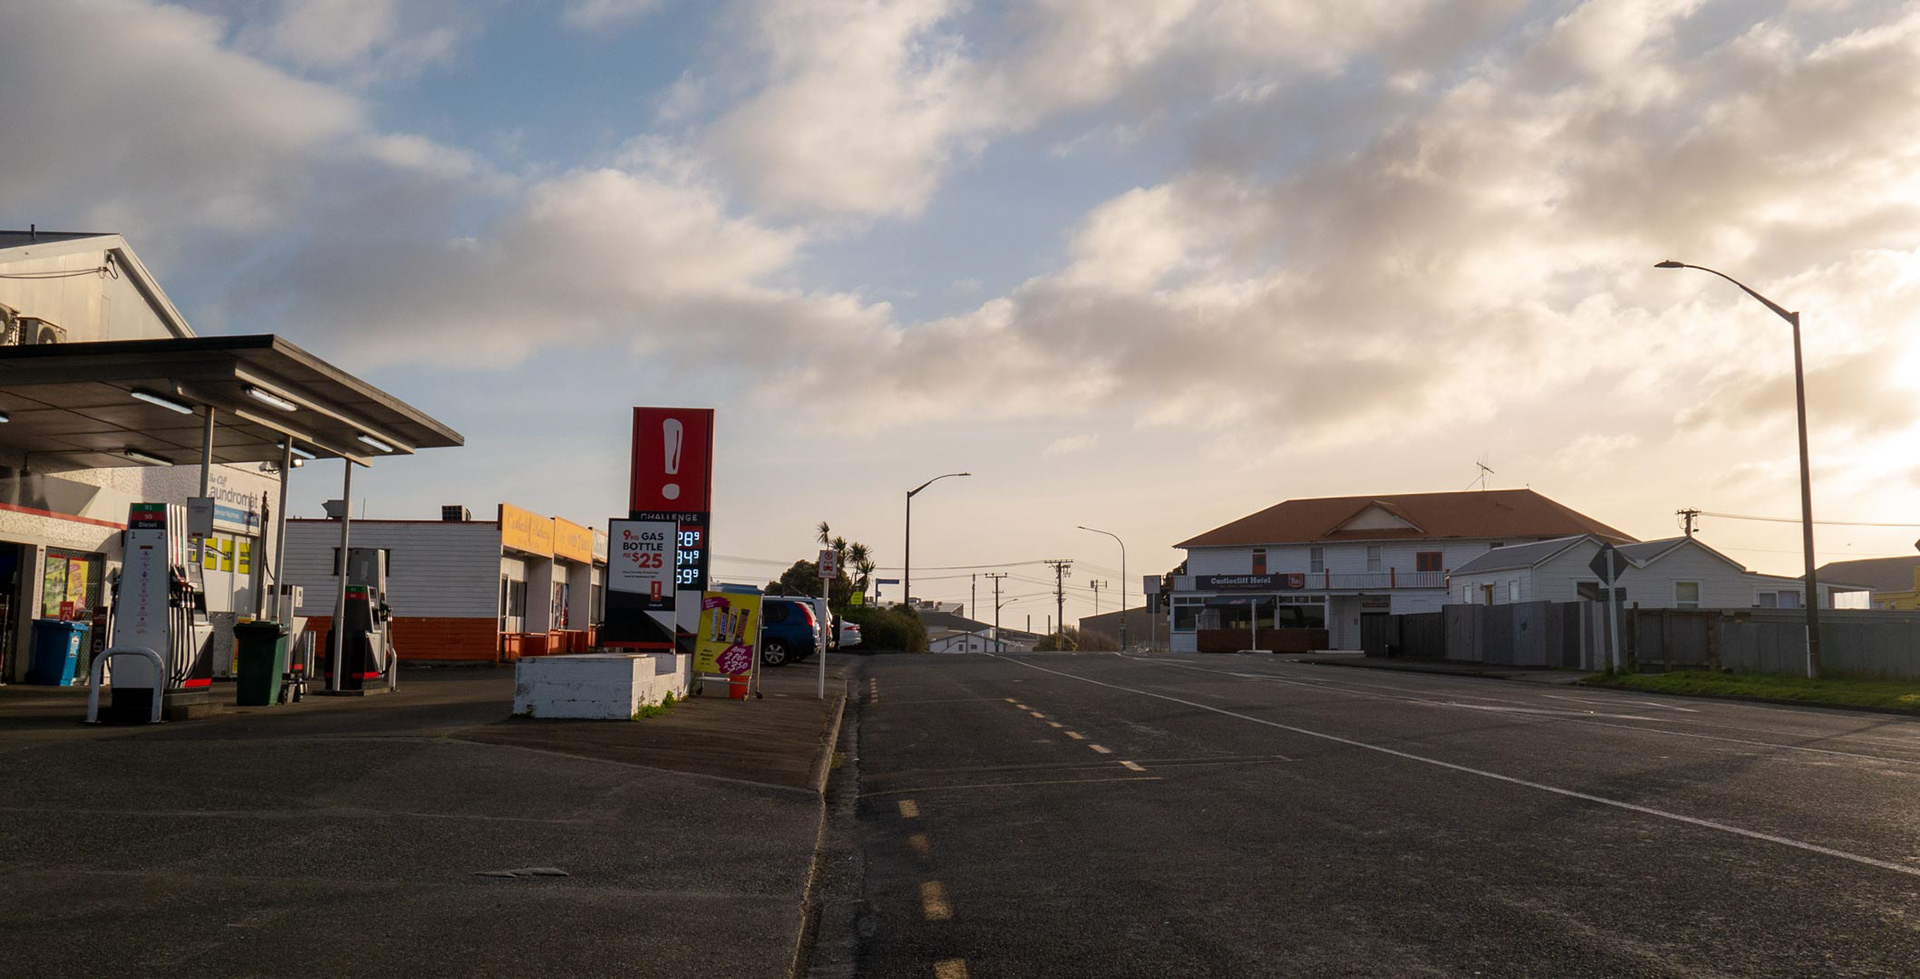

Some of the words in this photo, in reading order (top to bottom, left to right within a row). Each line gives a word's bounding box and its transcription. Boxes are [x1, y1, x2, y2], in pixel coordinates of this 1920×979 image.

[209, 486, 258, 508] aundromat
[640, 513, 698, 522] CHALLENGE
[131, 531, 136, 540] 1
[157, 531, 164, 540] 2
[641, 532, 664, 541] GAS
[623, 542, 663, 551] BOTTLE
[631, 551, 663, 569] $25
[1211, 577, 1248, 585] Castlecliff
[731, 645, 747, 656] Any
[724, 652, 733, 660] 2
[731, 652, 748, 662] for
